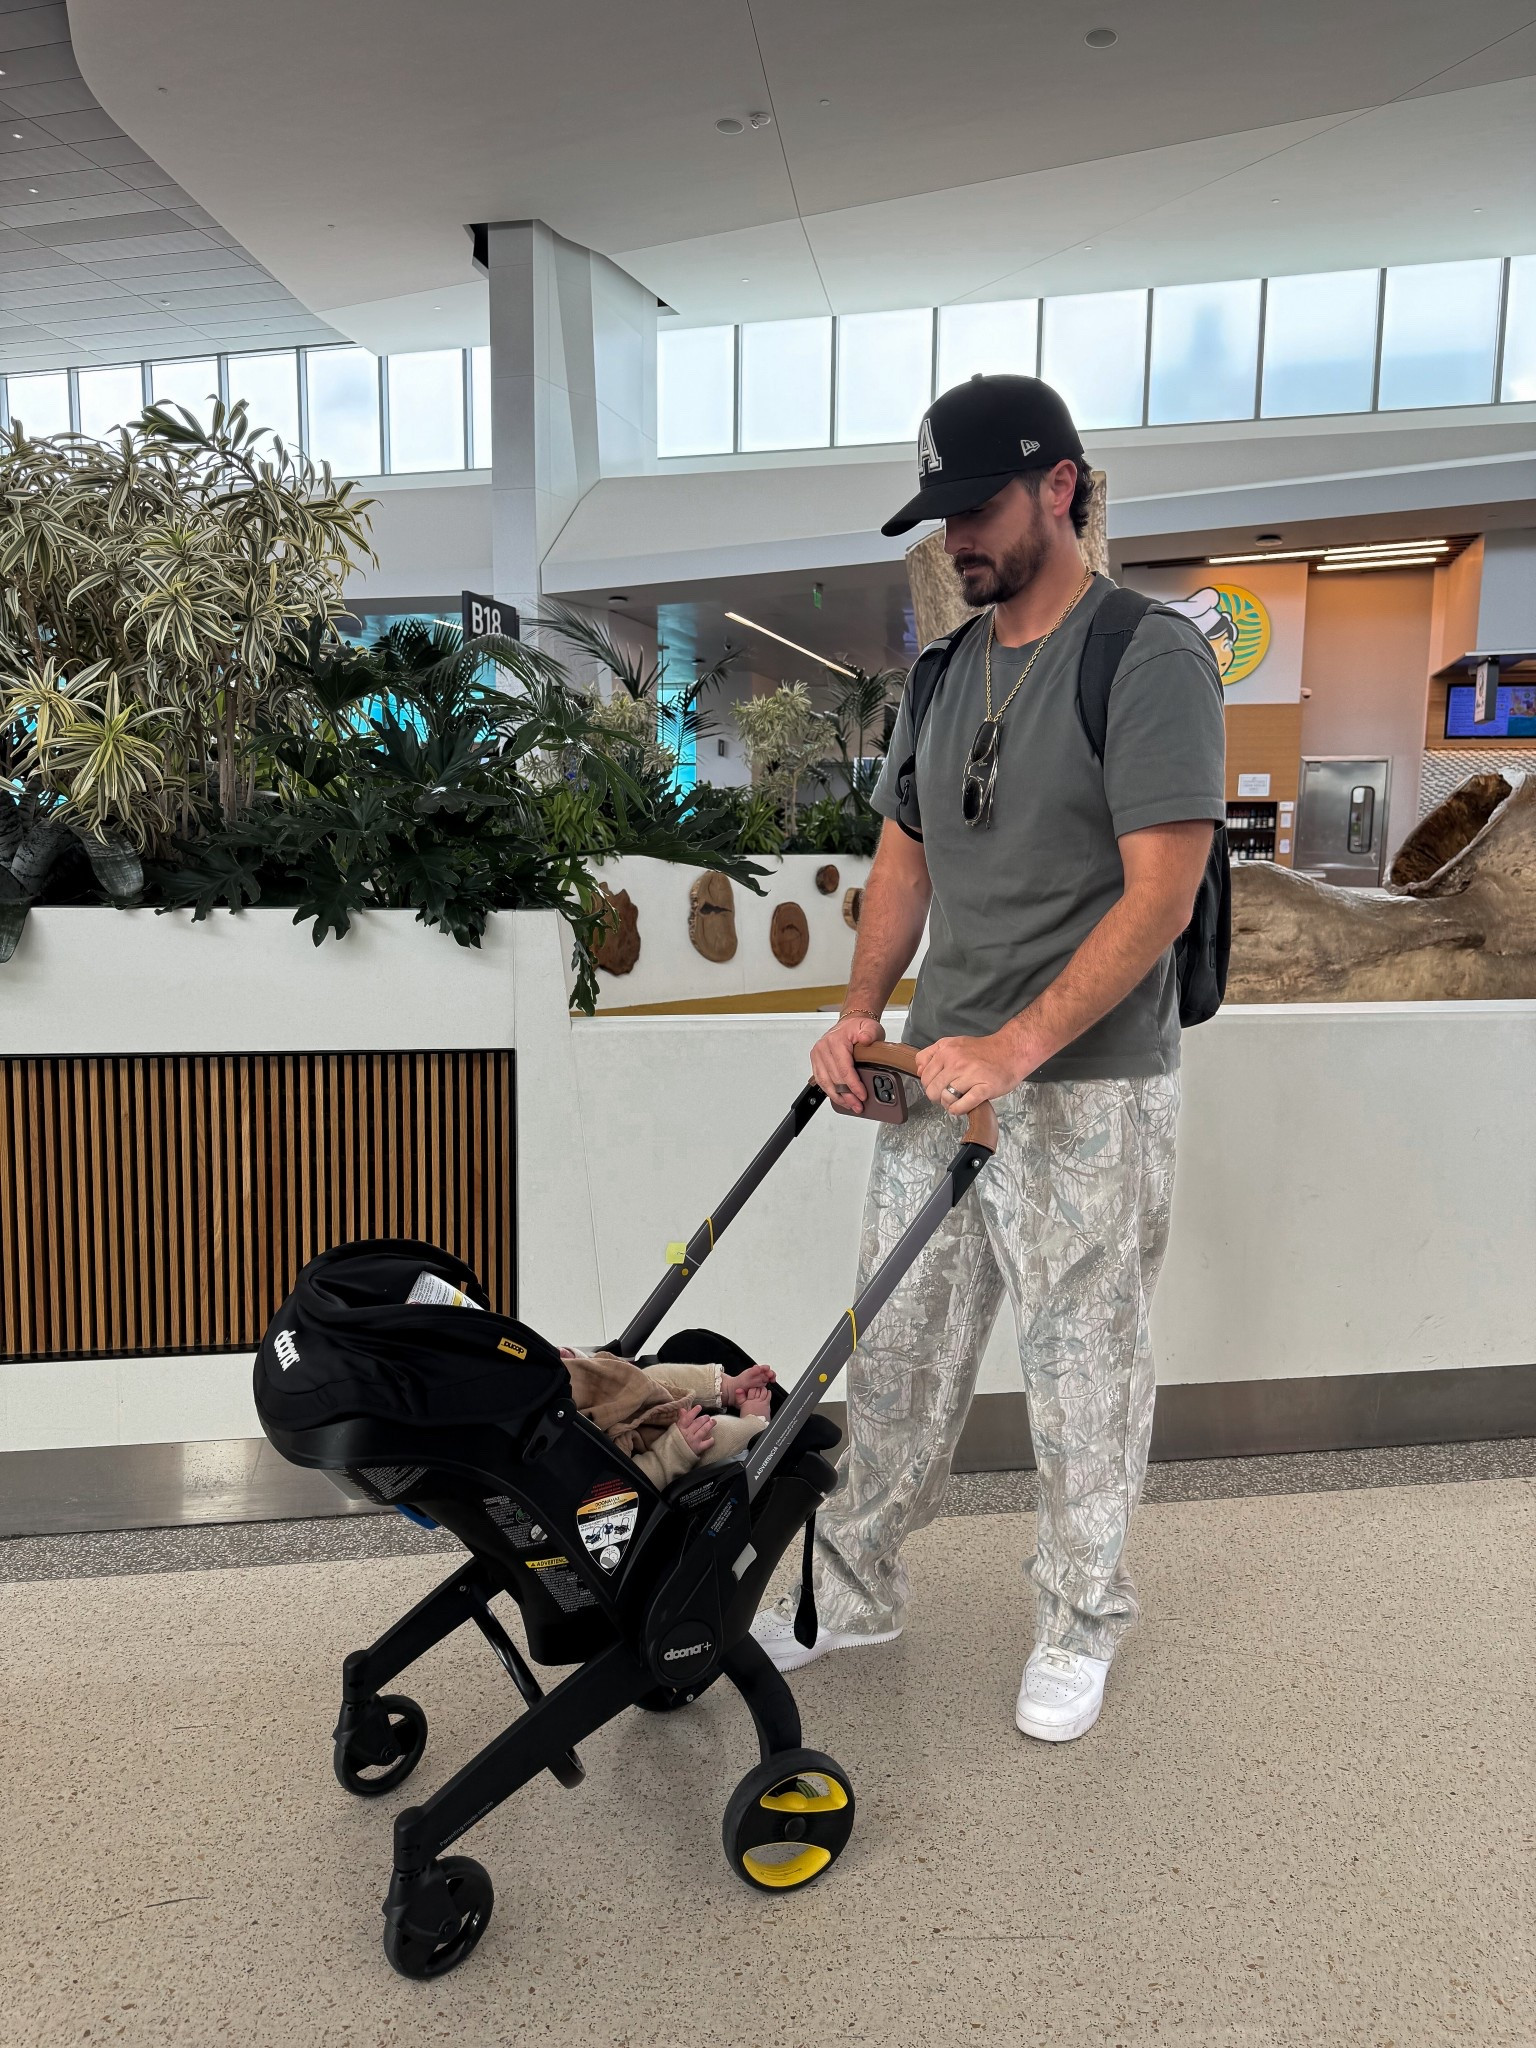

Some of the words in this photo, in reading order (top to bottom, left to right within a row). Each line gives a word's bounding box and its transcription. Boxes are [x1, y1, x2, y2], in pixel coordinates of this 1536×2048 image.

[918, 418, 943, 478] A
[471, 601, 502, 635] B18
[274, 1330, 300, 1371] doona
[503, 1341, 525, 1354] doona
[756, 1446, 779, 1476] ADVERTENCIA
